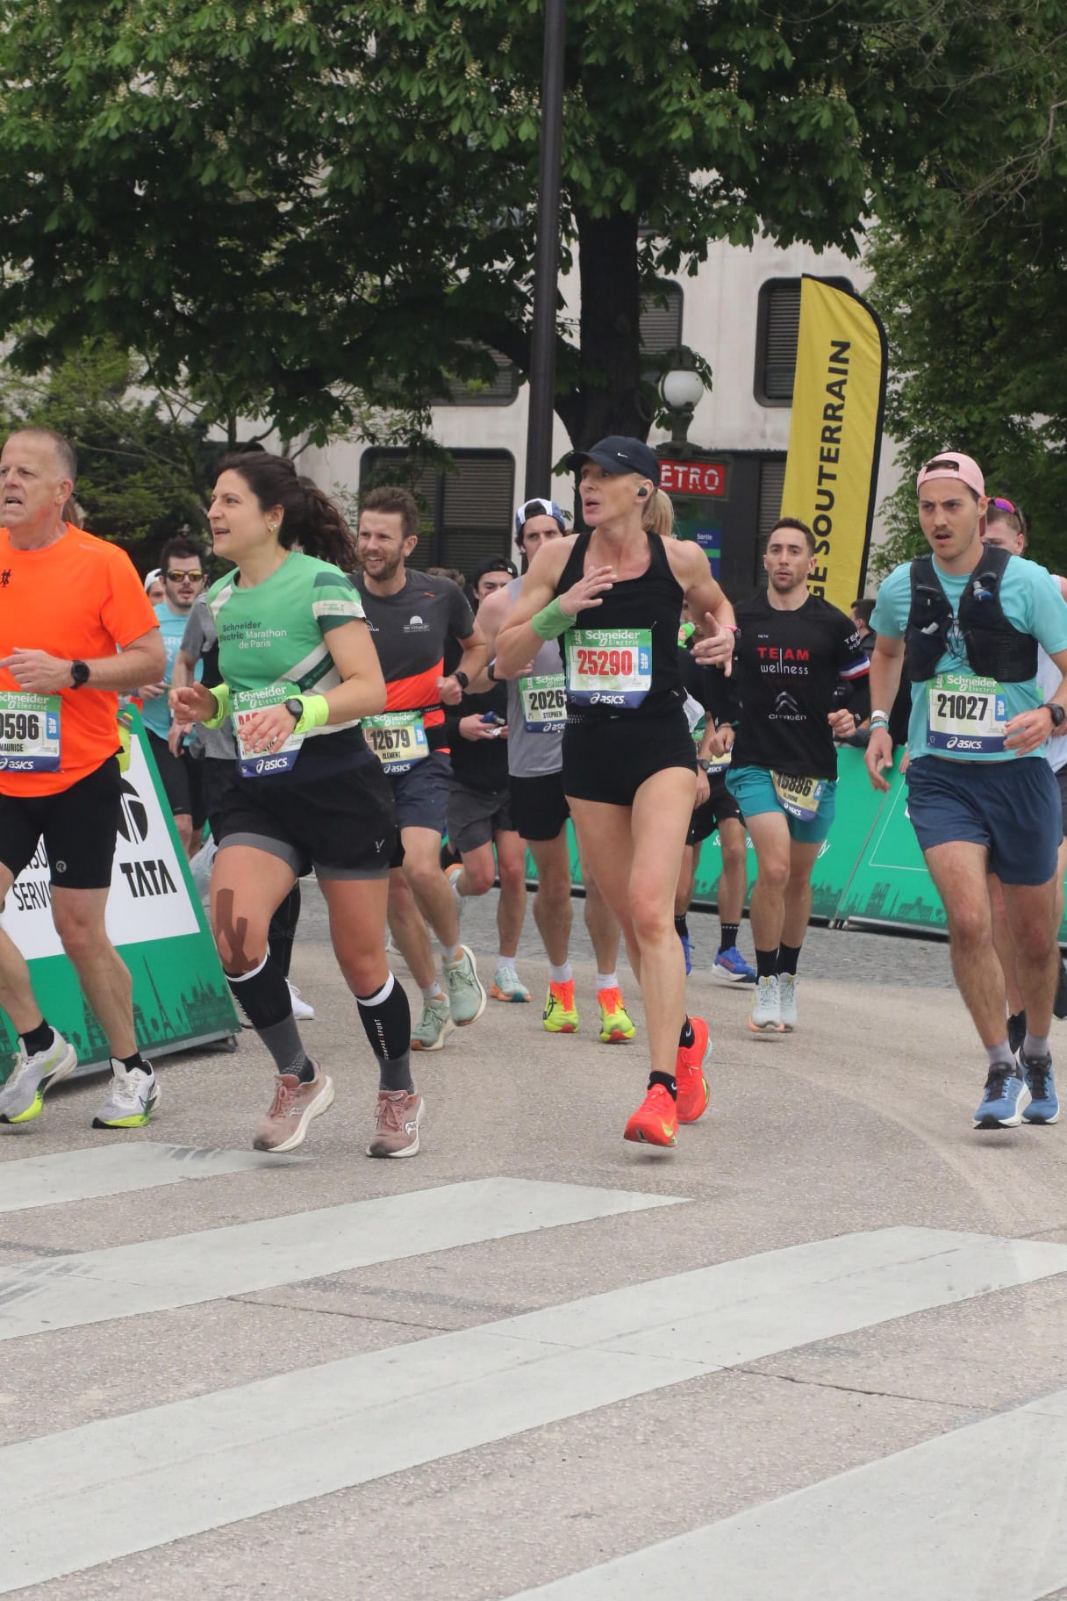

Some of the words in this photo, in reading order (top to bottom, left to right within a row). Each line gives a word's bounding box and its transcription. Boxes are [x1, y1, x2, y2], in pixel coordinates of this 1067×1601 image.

[812, 340, 851, 556] SOUTERRAIN
[223, 621, 262, 632] Schneider
[245, 628, 288, 639] Marathon
[585, 629, 640, 641] Schneider
[238, 640, 249, 649] de
[250, 639, 272, 649] Paris
[757, 647, 810, 660] TEAM
[577, 649, 633, 676] 25290
[760, 661, 809, 675] wellness
[946, 675, 997, 687] Schneider
[239, 686, 287, 702] Schneider
[937, 693, 989, 721] 21027
[371, 729, 411, 750] 12679
[119, 859, 178, 898] TATA
[12, 879, 51, 911] SERVI
